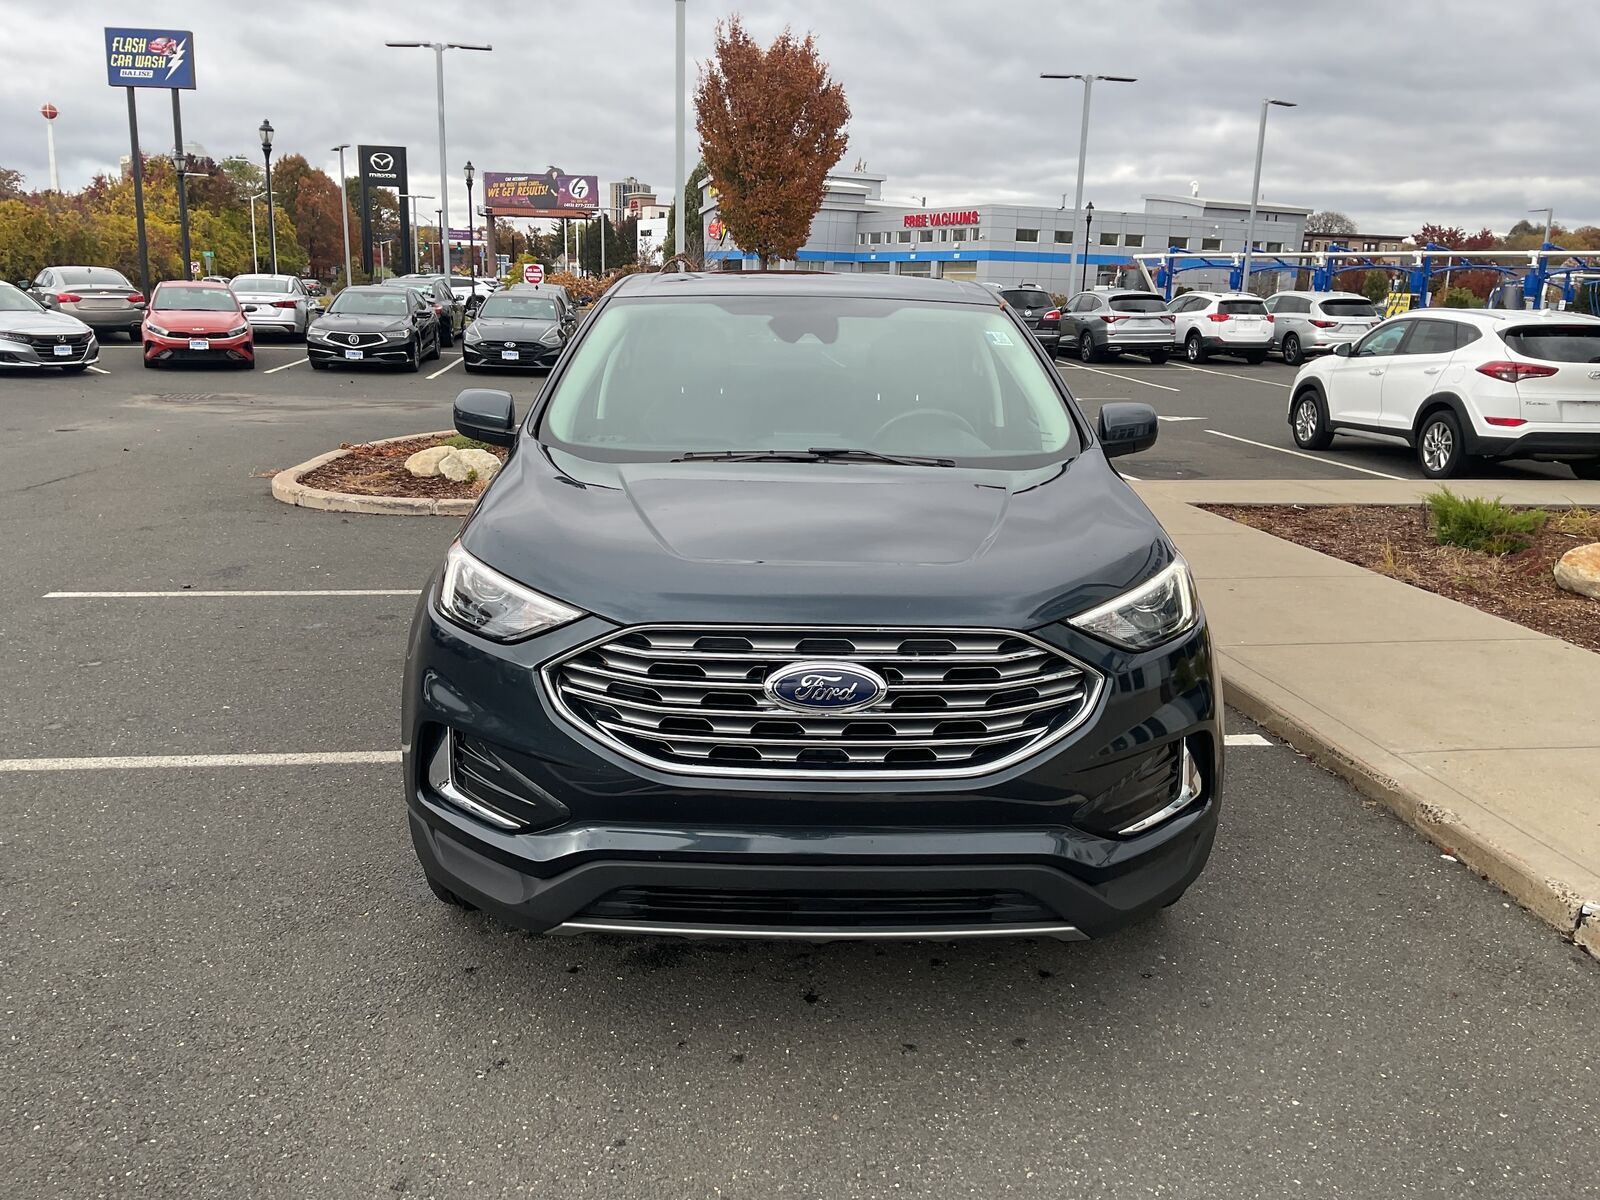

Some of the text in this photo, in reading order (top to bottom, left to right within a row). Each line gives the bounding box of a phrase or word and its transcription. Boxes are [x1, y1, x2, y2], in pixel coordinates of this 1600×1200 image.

[112, 37, 147, 53] FLASH
[110, 54, 166, 69] CAR WASH
[487, 185, 549, 198] WE GET RESULTS!
[903, 210, 980, 228] FREE VACUUMS
[794, 674, 858, 701] Ford
